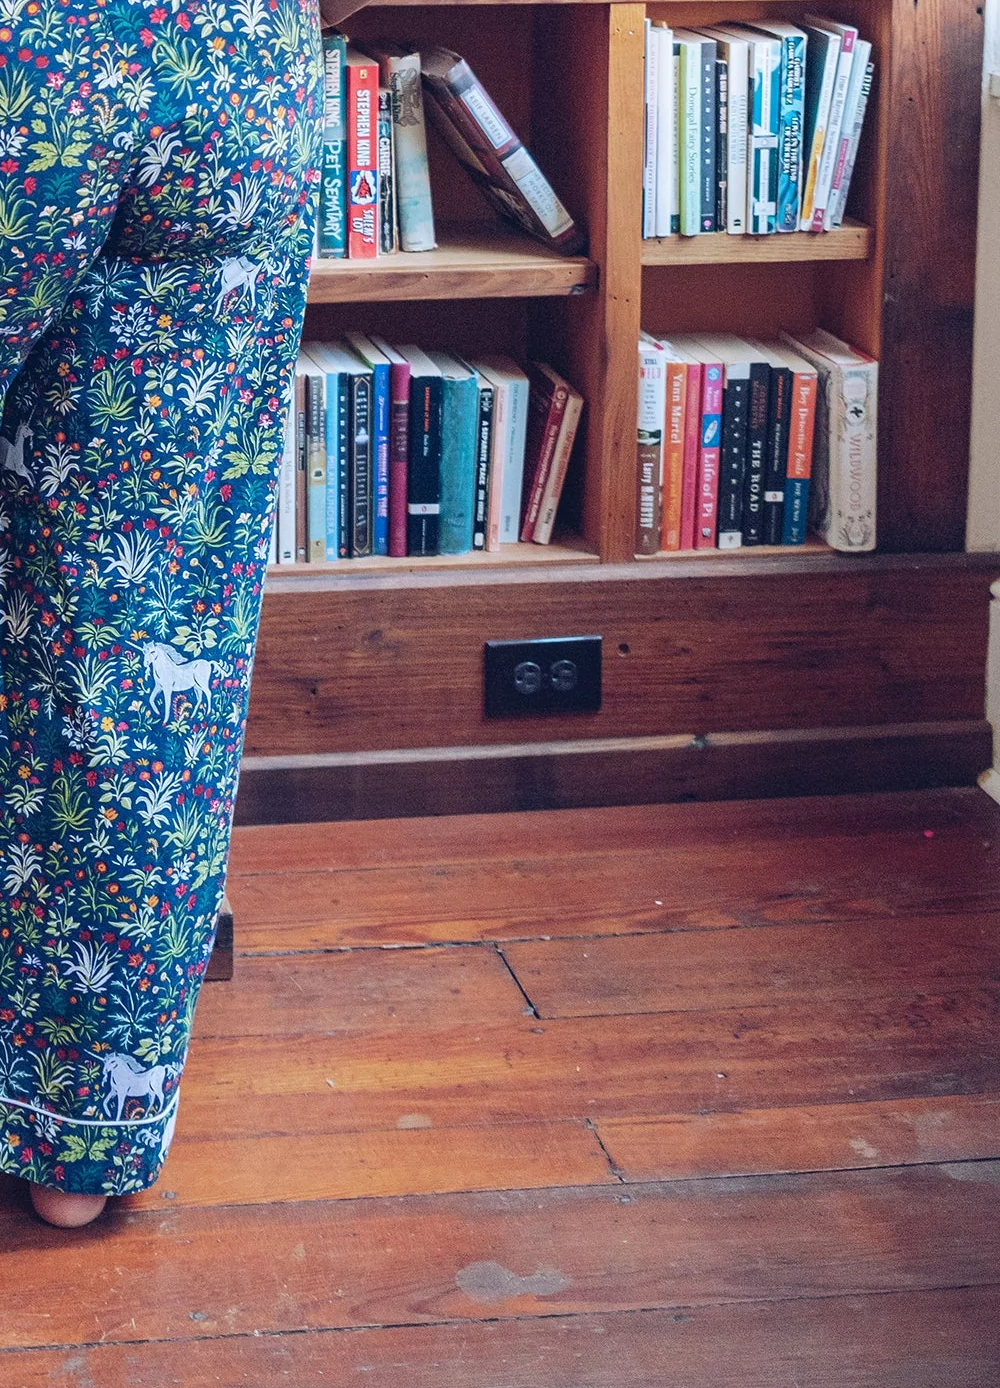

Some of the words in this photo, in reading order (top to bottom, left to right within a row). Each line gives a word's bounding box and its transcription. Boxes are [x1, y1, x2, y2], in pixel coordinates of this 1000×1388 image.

[324, 49, 340, 97] STEPHEN
[325, 97, 340, 128] KING
[356, 89, 371, 137] STEPHEN
[686, 86, 698, 127] Donegal
[481, 112, 505, 142] LARSEN
[687, 127, 698, 150] Fairy
[323, 140, 342, 174] PET
[356, 139, 371, 167] KING
[379, 137, 390, 177] CARRIE
[687, 152, 698, 184] Stories
[322, 176, 343, 242] SEMATARY
[352, 217, 364, 234] LOT
[672, 373, 683, 402] Yann
[798, 386, 810, 405] Boy
[671, 405, 682, 445] Martel
[797, 407, 809, 451] Detective
[702, 452, 716, 481] Life
[751, 440, 762, 468] THE
[794, 452, 806, 475] Fails
[327, 455, 335, 487] MILAN
[848, 433, 861, 510] WILDWOOD
[702, 483, 714, 498] of
[749, 474, 760, 513] ROAD
[326, 488, 335, 535] KUNDERA
[701, 502, 714, 518] Pi
